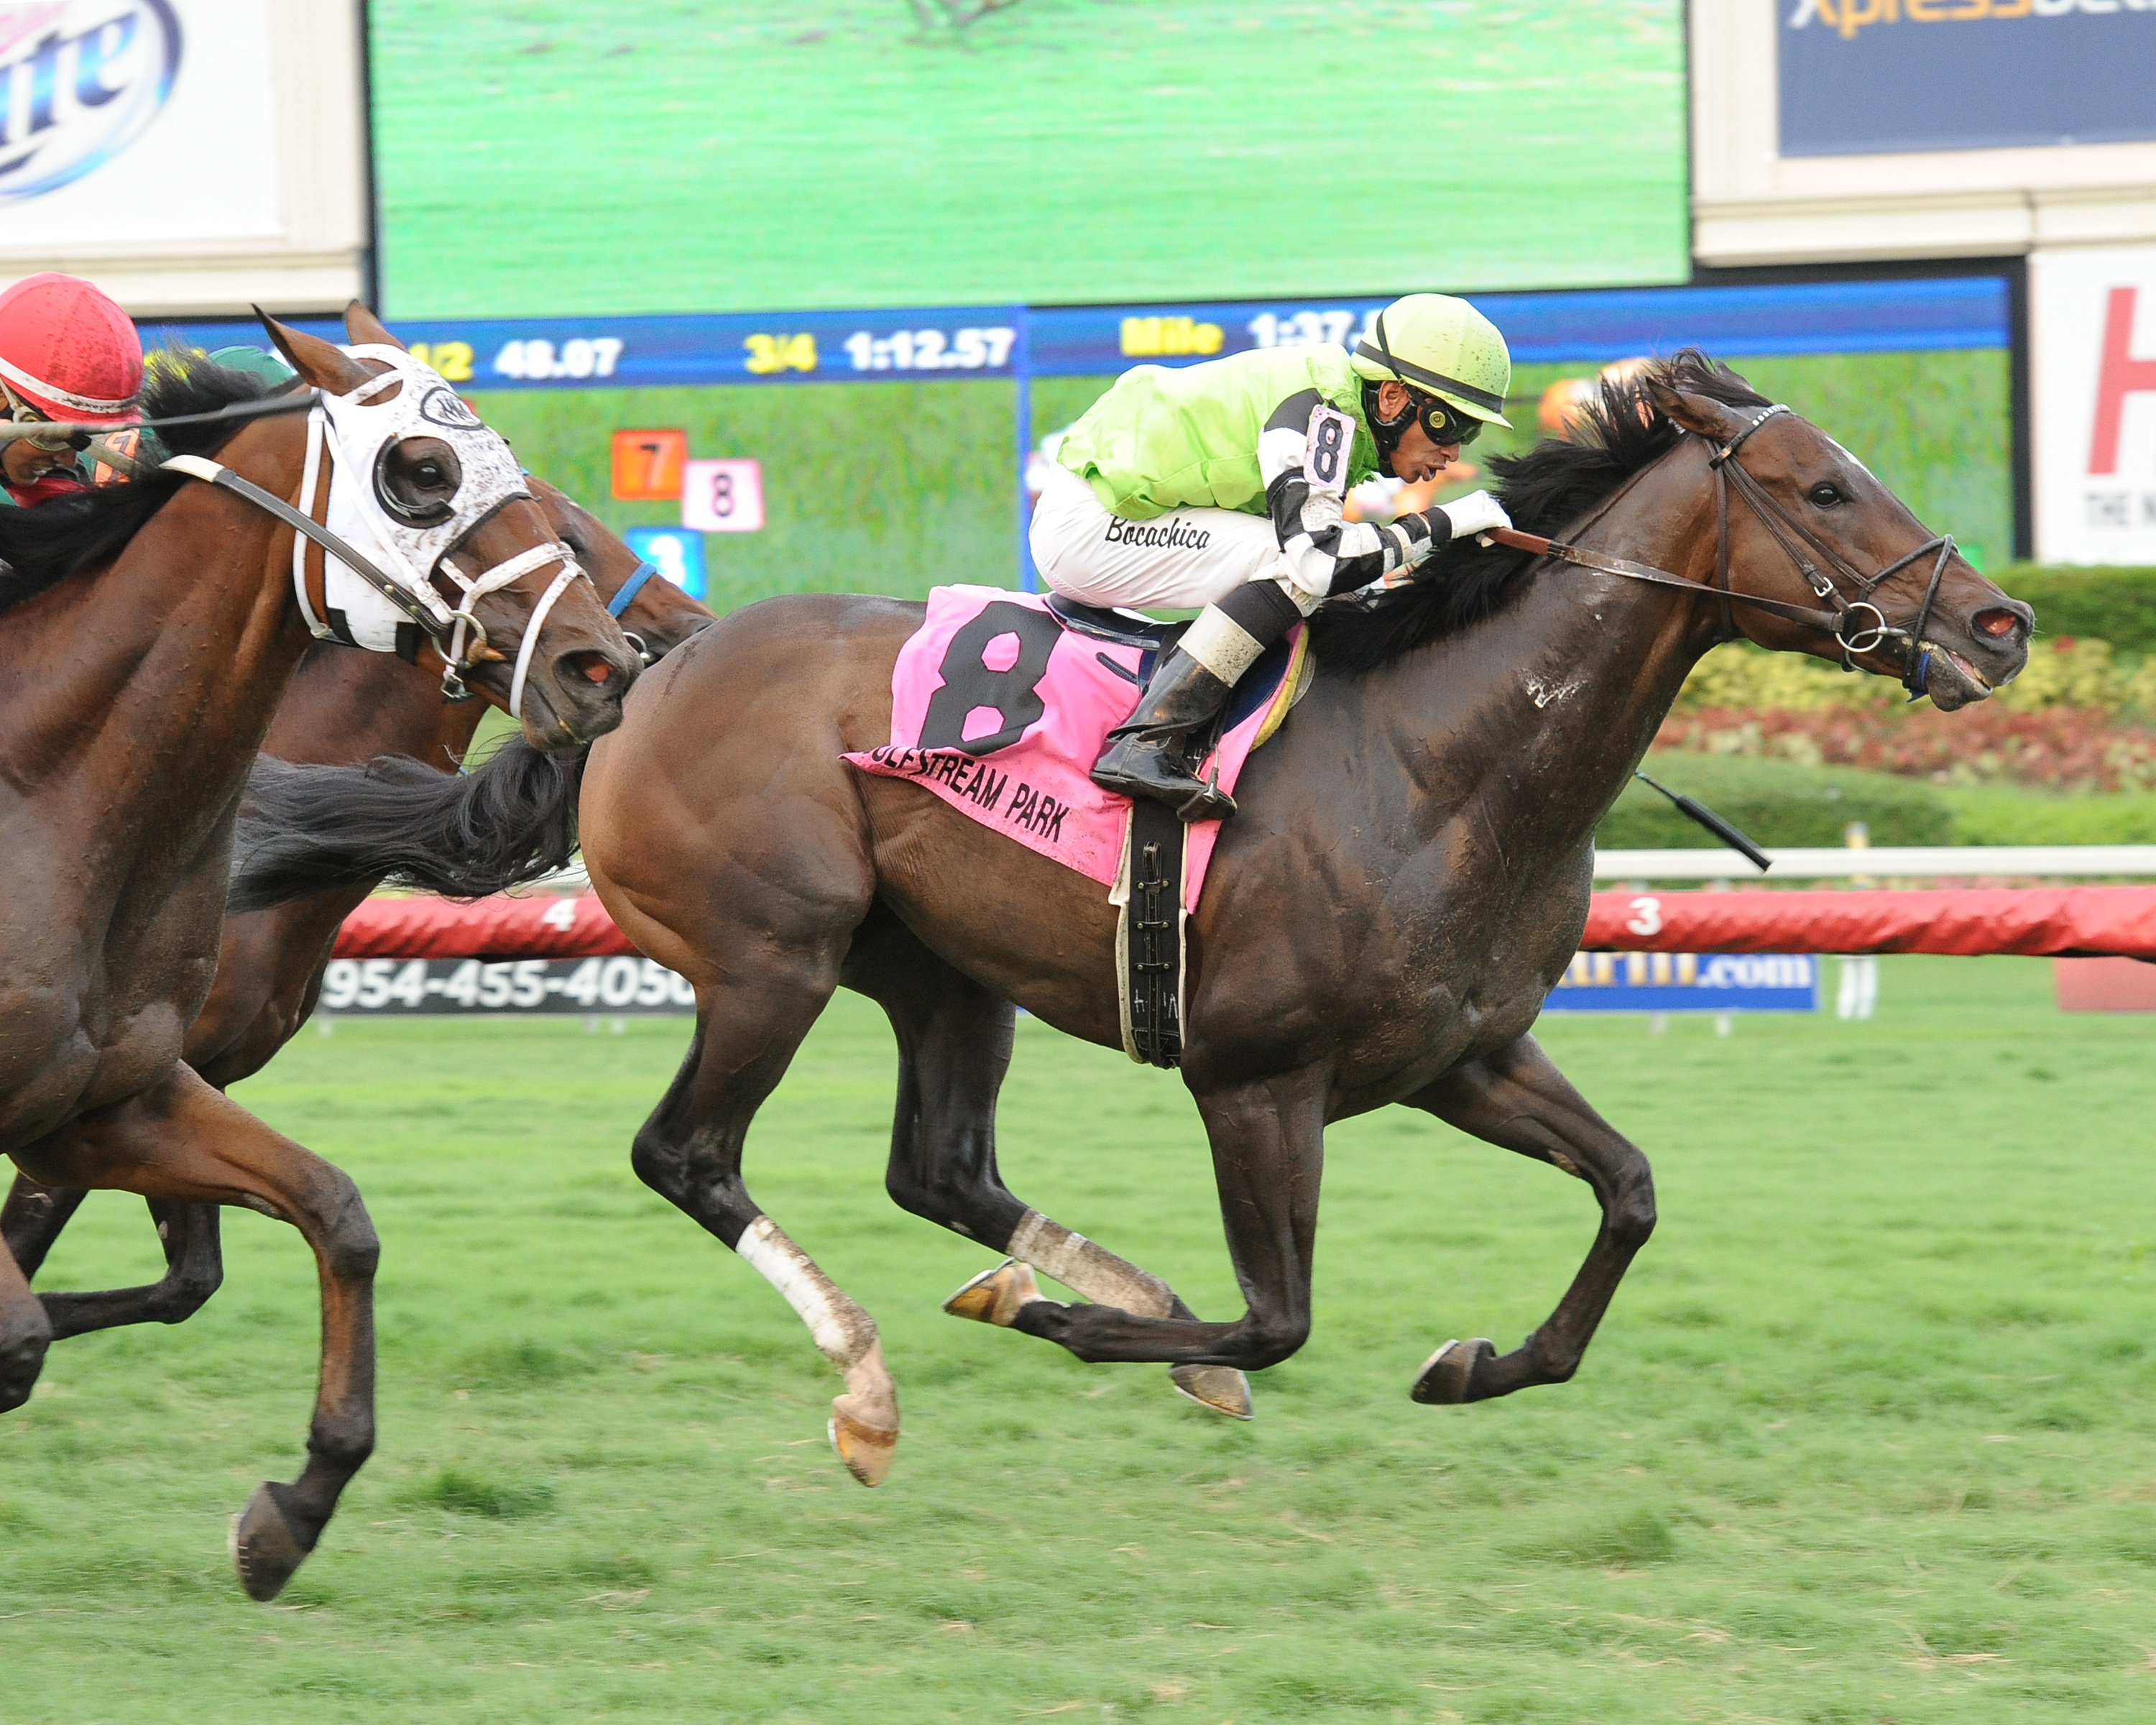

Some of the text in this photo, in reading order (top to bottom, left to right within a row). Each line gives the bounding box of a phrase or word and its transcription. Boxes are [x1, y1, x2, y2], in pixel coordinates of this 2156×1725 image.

[494, 337, 624, 379] 48.07
[744, 332, 817, 374] 3/4
[843, 327, 1017, 370] 1:12.57
[1121, 316, 1223, 355] Mile
[1314, 417, 1344, 483] 8
[711, 472, 734, 519] 8
[1105, 513, 1211, 550] Bocachica
[648, 533, 686, 586] 3
[918, 600, 1067, 757] 8
[865, 747, 1070, 843] ULFSTREAM PARK
[542, 898, 576, 932] 4
[1627, 897, 1663, 936] 3
